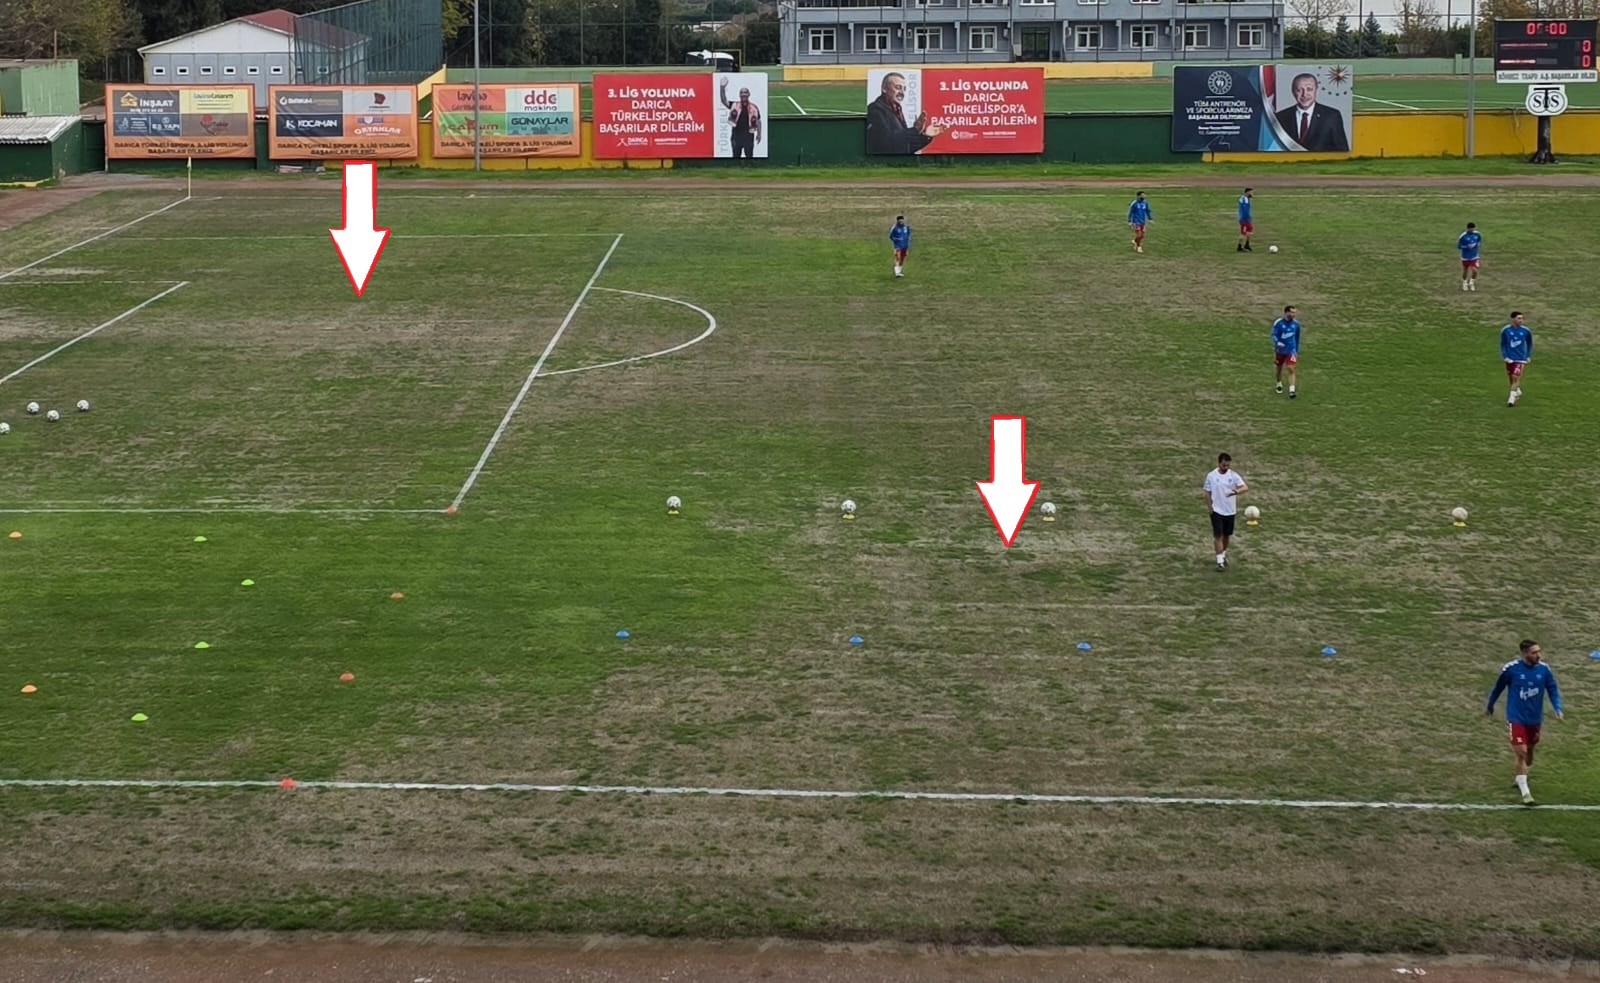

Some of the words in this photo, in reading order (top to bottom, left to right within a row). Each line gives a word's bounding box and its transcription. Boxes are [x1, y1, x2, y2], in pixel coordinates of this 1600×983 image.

[1582, 40, 1591, 52] 0
[1582, 55, 1591, 67] 0
[939, 81, 949, 91] 3.
[951, 79, 971, 91] LİG
[973, 80, 1029, 91] YOLUNDA
[607, 88, 617, 98] 3.
[619, 86, 639, 98] LİG
[640, 88, 696, 98] YOLUNDA
[963, 92, 1005, 102] DARICA
[631, 100, 672, 109] DARICA
[942, 103, 1026, 114] TÜRKELİSPOR'A
[511, 116, 567, 126] GÜNAYLAR
[610, 109, 693, 121] TÜRKELİSPOR'A
[930, 116, 989, 128] BAŞARILAR
[992, 114, 1037, 125] DİLERİM
[298, 119, 338, 128] KOCAMAN
[599, 123, 657, 135] BAŞARILAR
[660, 121, 705, 133] DİLERİM
